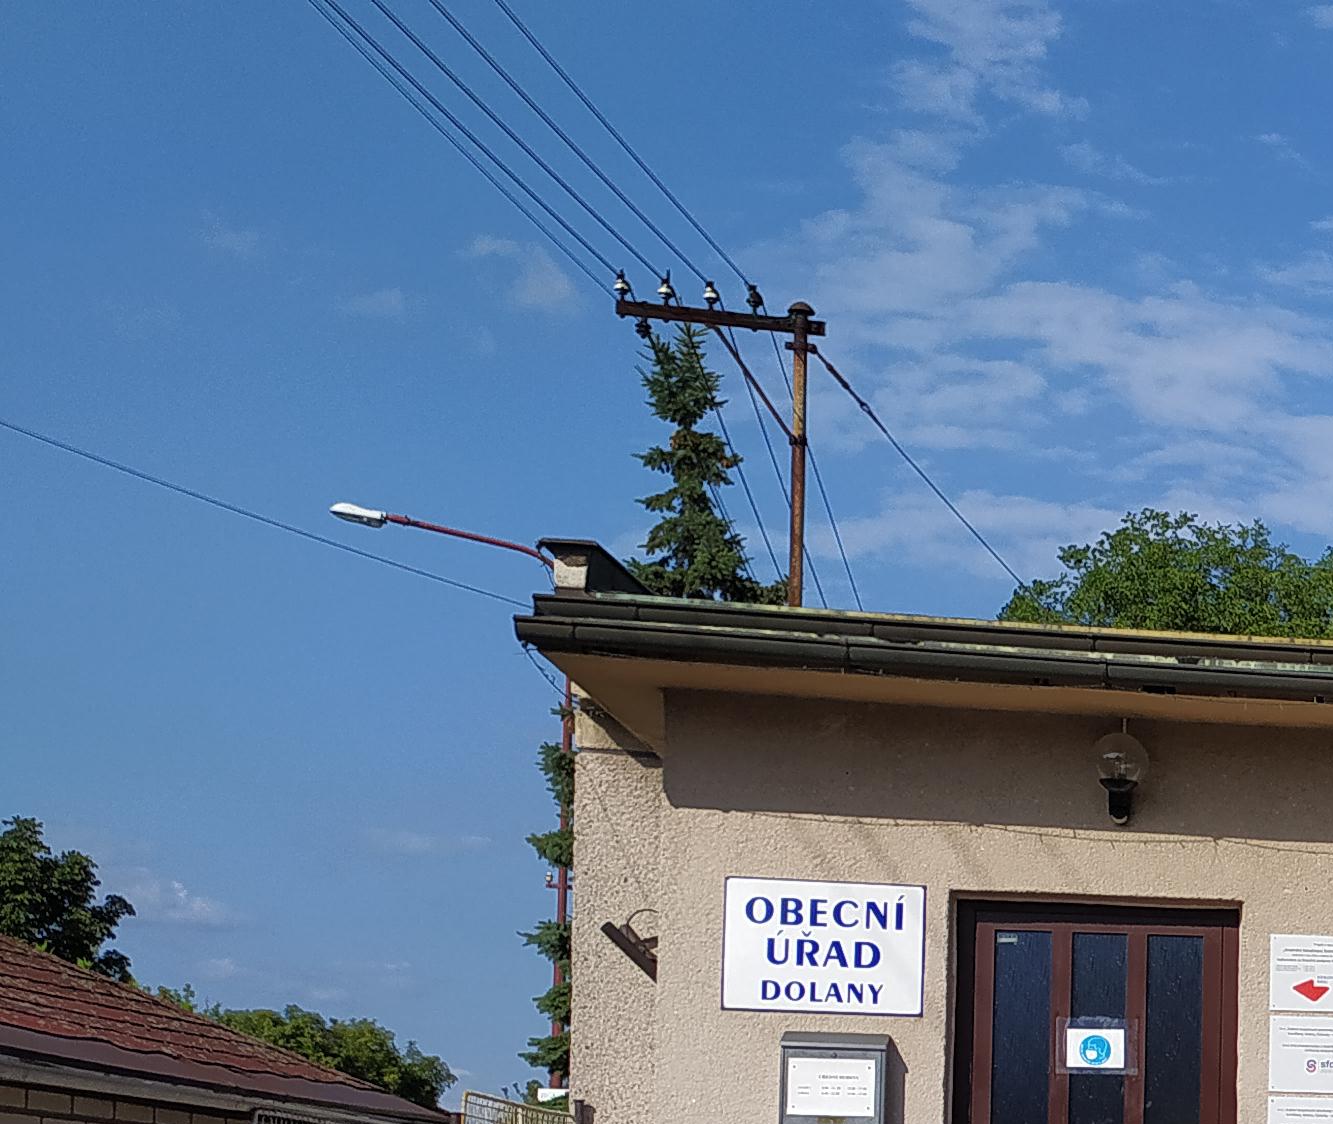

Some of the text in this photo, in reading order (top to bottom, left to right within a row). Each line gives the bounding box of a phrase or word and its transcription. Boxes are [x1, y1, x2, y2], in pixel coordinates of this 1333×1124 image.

[745, 895, 905, 930] OBECNÍ
[766, 930, 881, 968] ÚŘAD
[761, 980, 883, 1004] DOLANY
